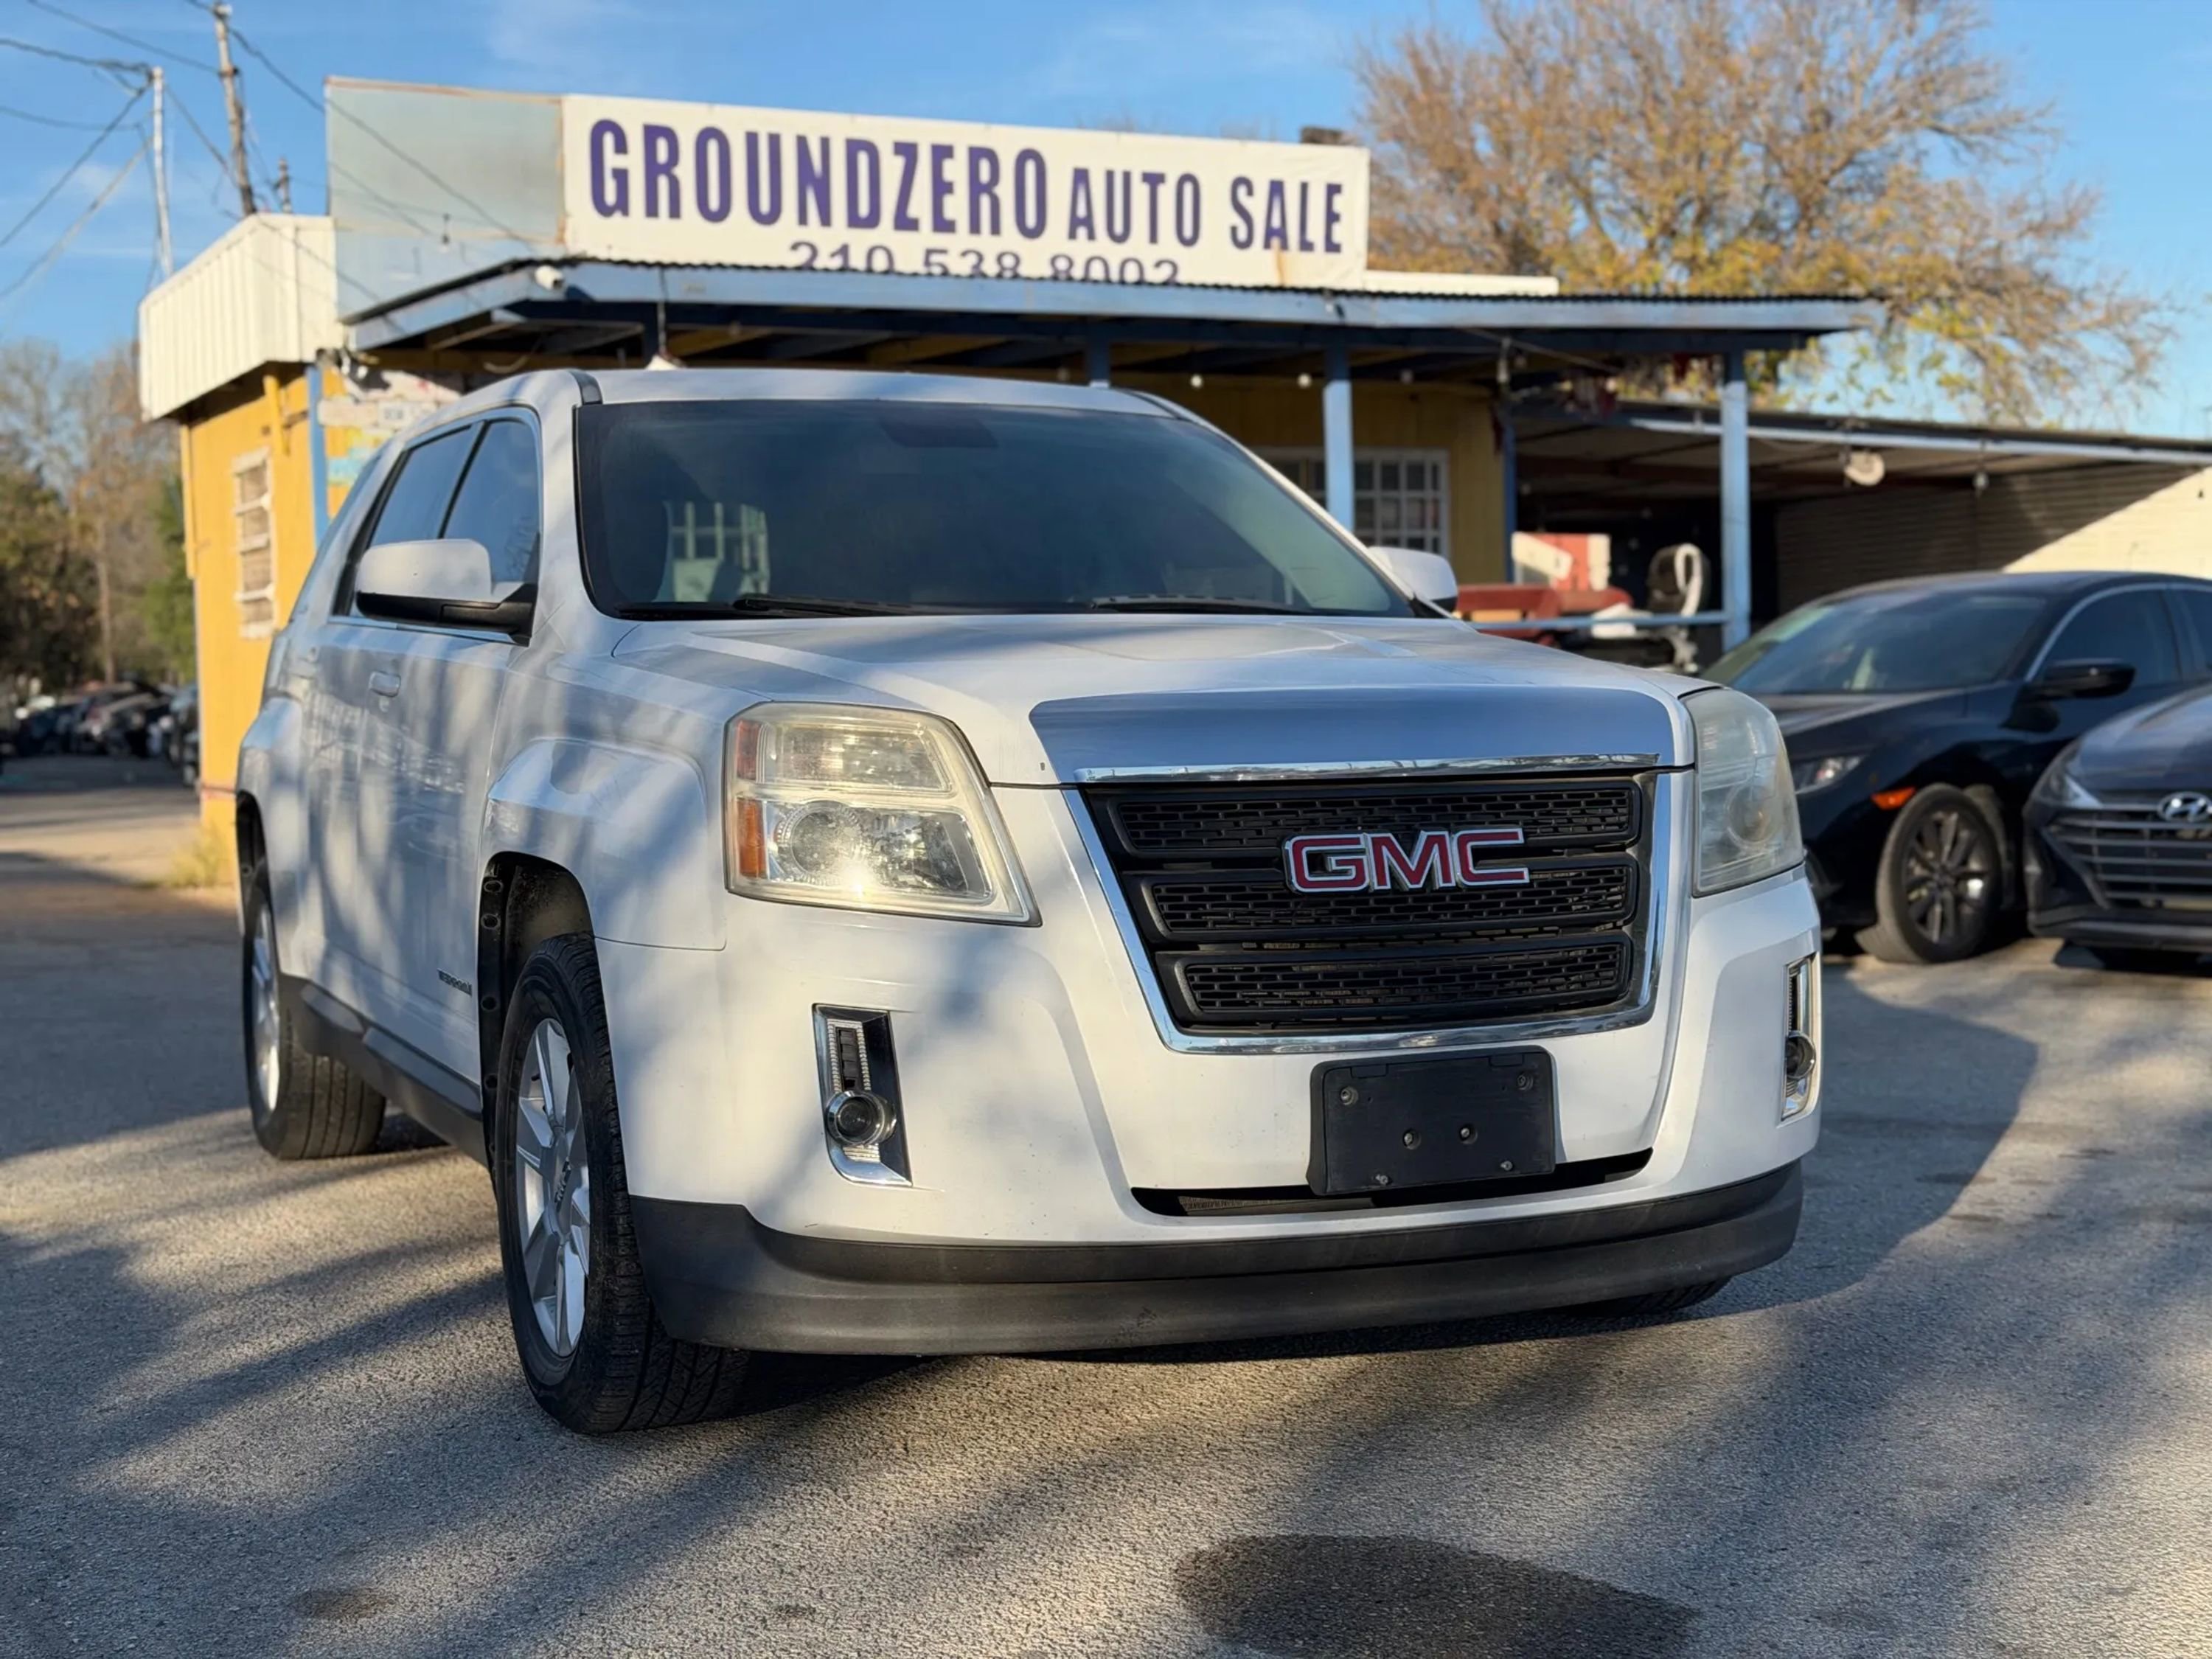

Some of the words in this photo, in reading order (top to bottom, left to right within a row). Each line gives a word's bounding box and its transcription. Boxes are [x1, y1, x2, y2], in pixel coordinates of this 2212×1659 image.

[590, 119, 1047, 240] GROUNDZERO
[1068, 167, 1200, 247] AUTO
[1231, 176, 1343, 254] SALE
[1284, 827, 1531, 892] GMC
